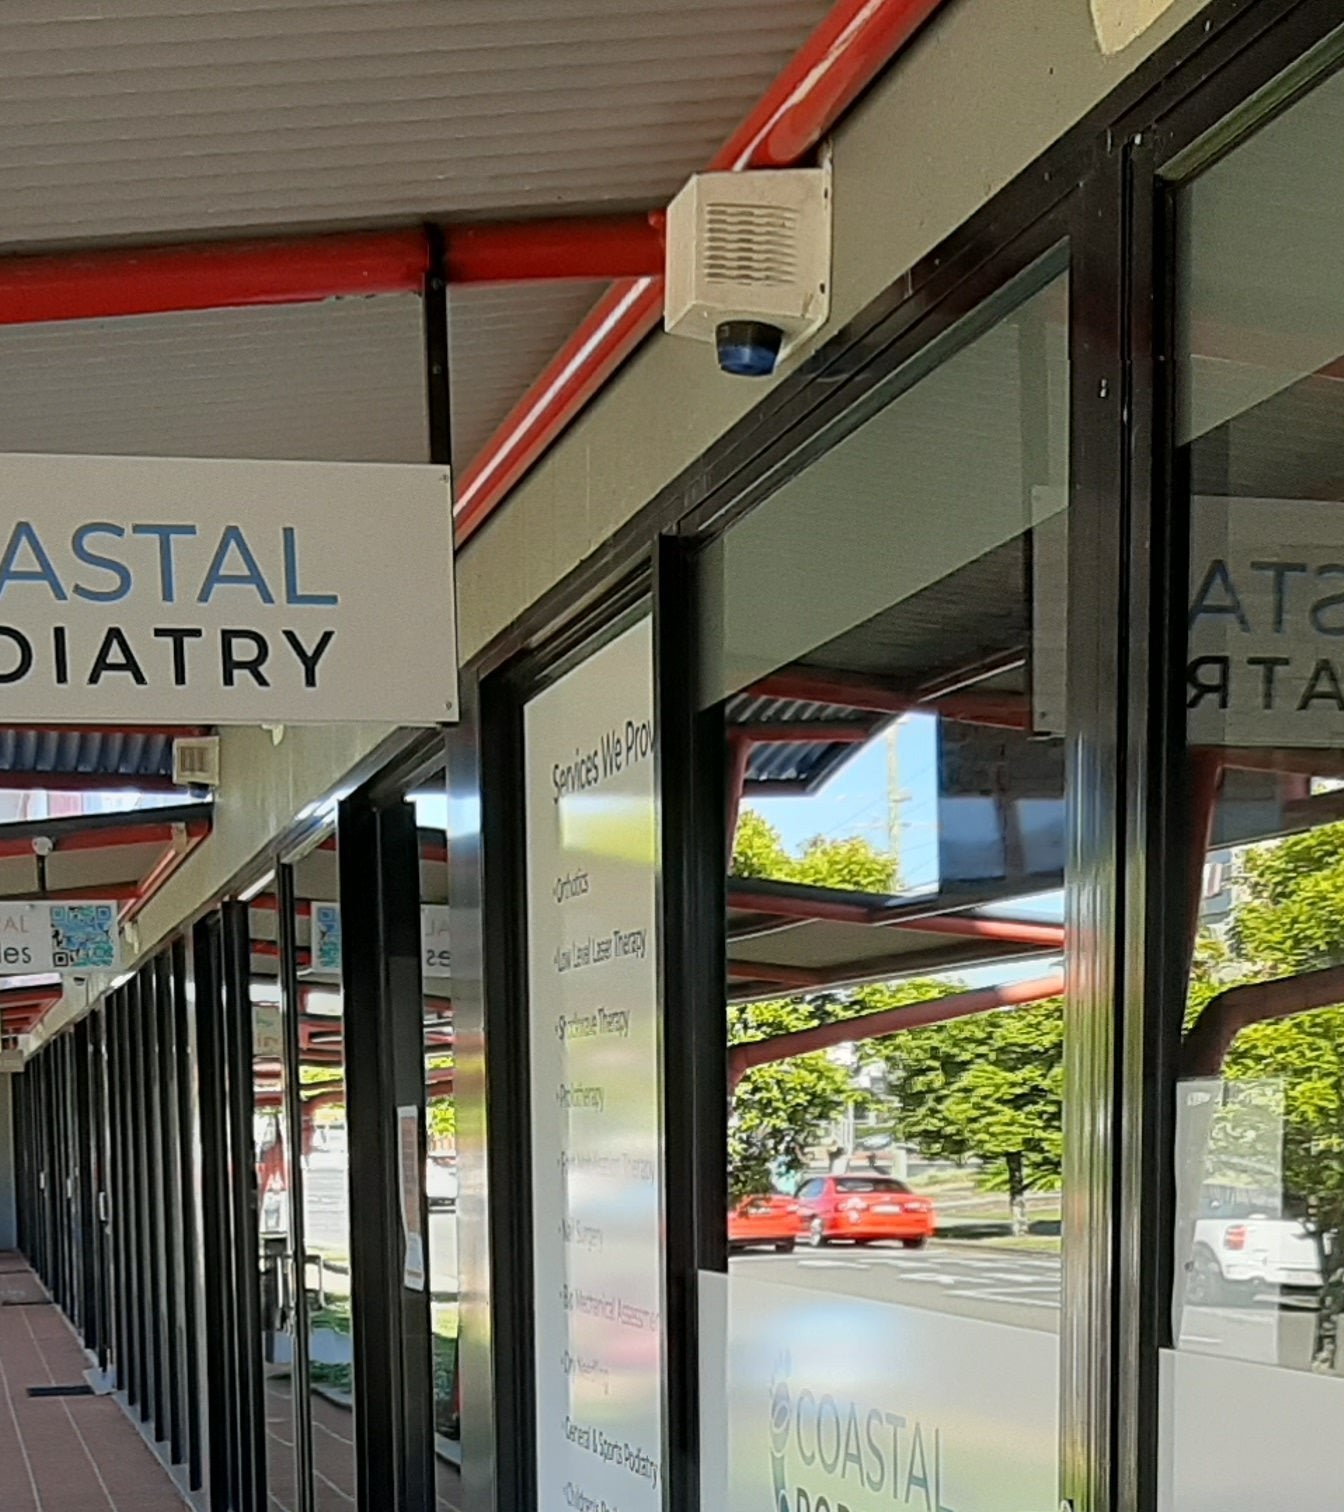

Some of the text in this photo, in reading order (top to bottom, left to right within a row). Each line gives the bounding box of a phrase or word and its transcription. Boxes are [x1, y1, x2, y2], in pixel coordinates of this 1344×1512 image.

[552, 747, 600, 804] Services
[600, 729, 623, 779] We
[612, 928, 648, 960] Therapy
[597, 1005, 631, 1038] Therapy
[623, 1443, 659, 1491] Podiatry
